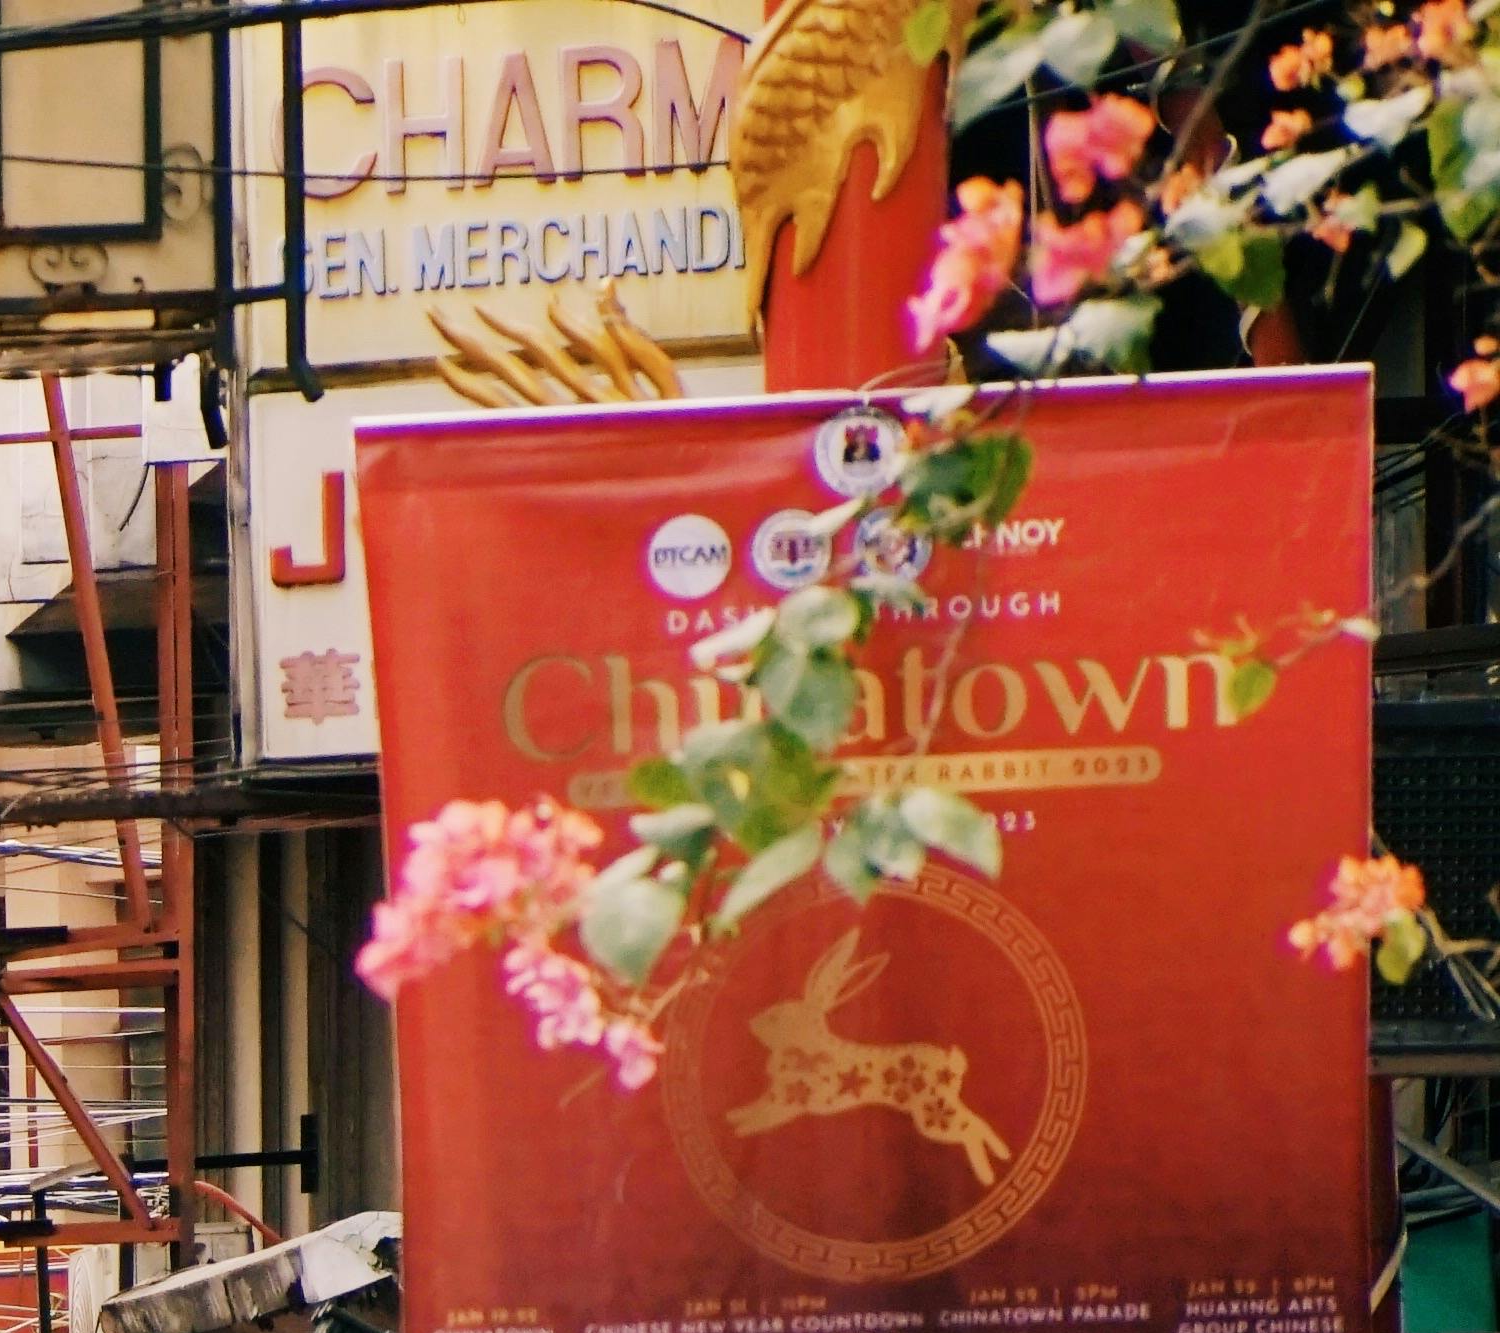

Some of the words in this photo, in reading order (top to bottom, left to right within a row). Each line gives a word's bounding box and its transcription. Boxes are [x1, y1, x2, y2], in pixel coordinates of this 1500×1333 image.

[502, 646, 1240, 763] Chiatown
[936, 758, 1056, 783] RABBIT
[938, 1304, 1064, 1327] CHINATOWN
[1069, 1302, 1151, 1322] PARADE
[1287, 1296, 1338, 1315] ARTS
[791, 1310, 925, 1333] COUNTDOWN
